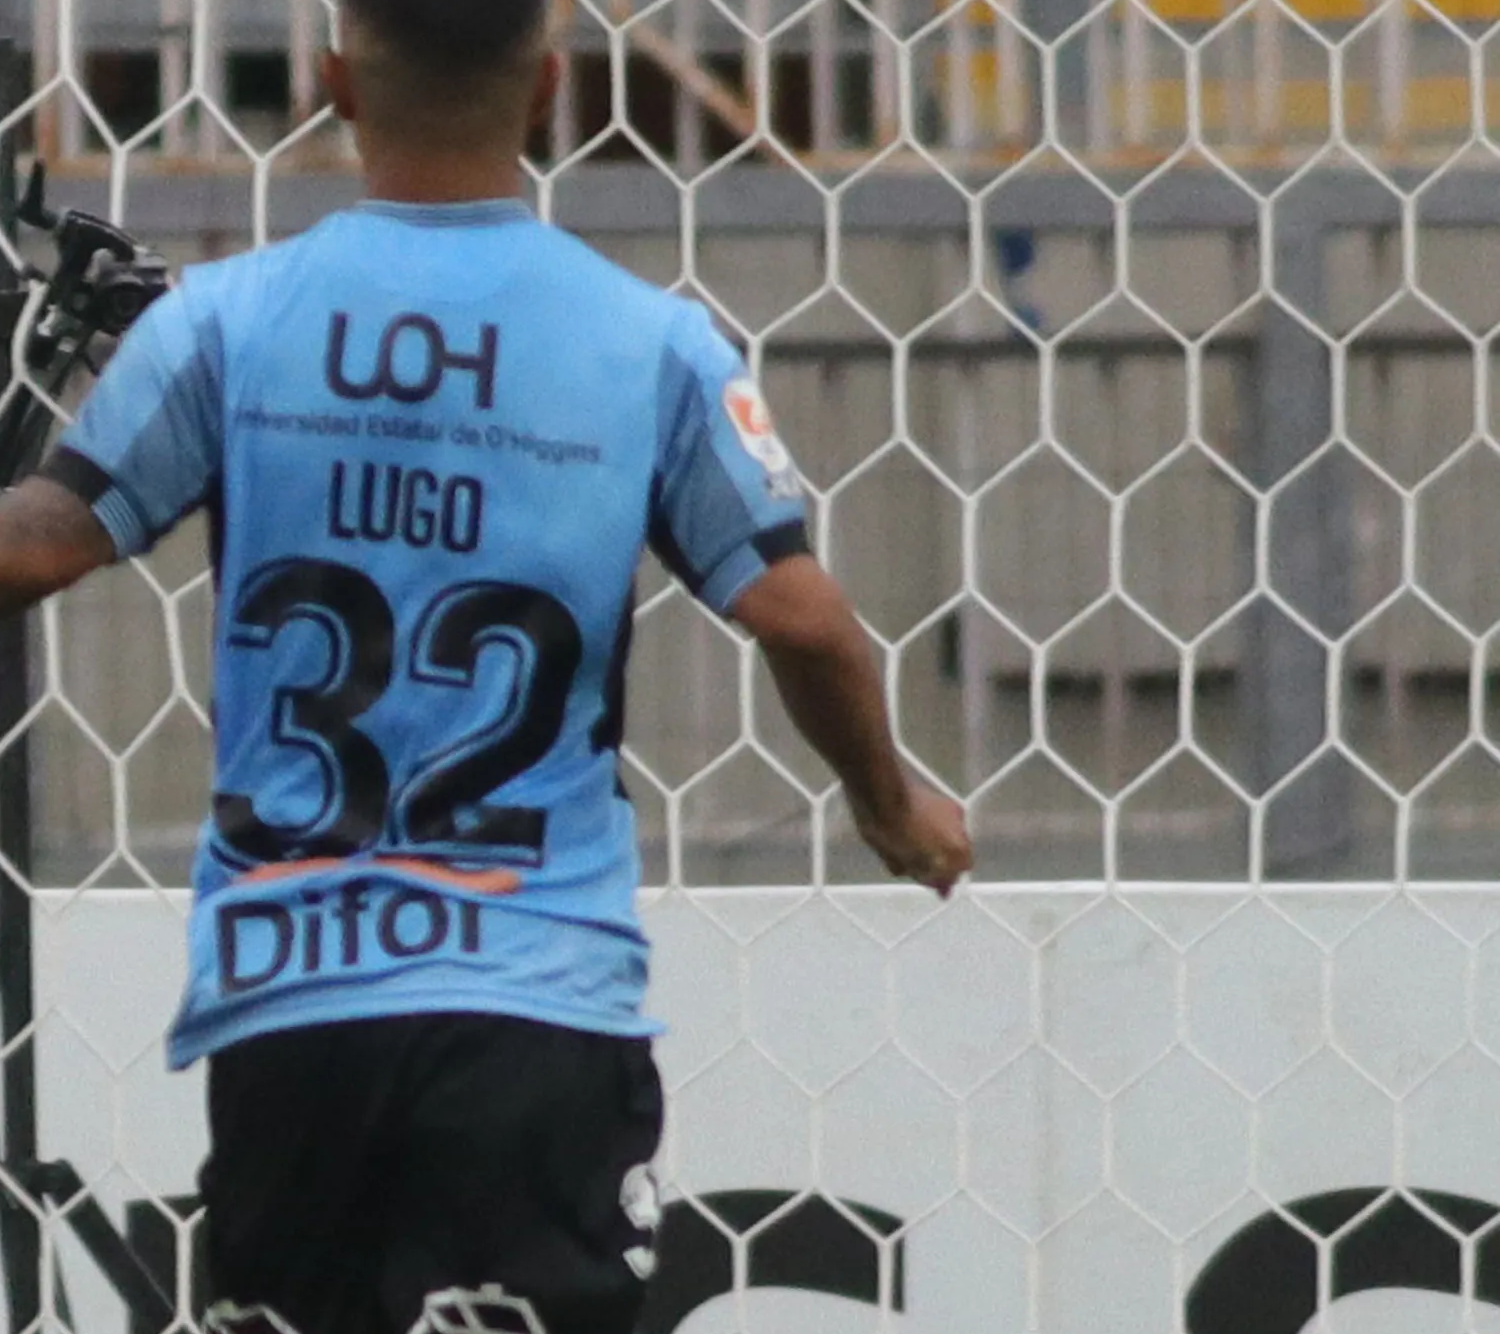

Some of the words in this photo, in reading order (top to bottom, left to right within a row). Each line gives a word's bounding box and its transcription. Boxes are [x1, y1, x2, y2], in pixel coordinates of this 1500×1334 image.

[324, 309, 498, 409] UOH
[328, 460, 484, 553] LUGO
[210, 556, 582, 872] 32
